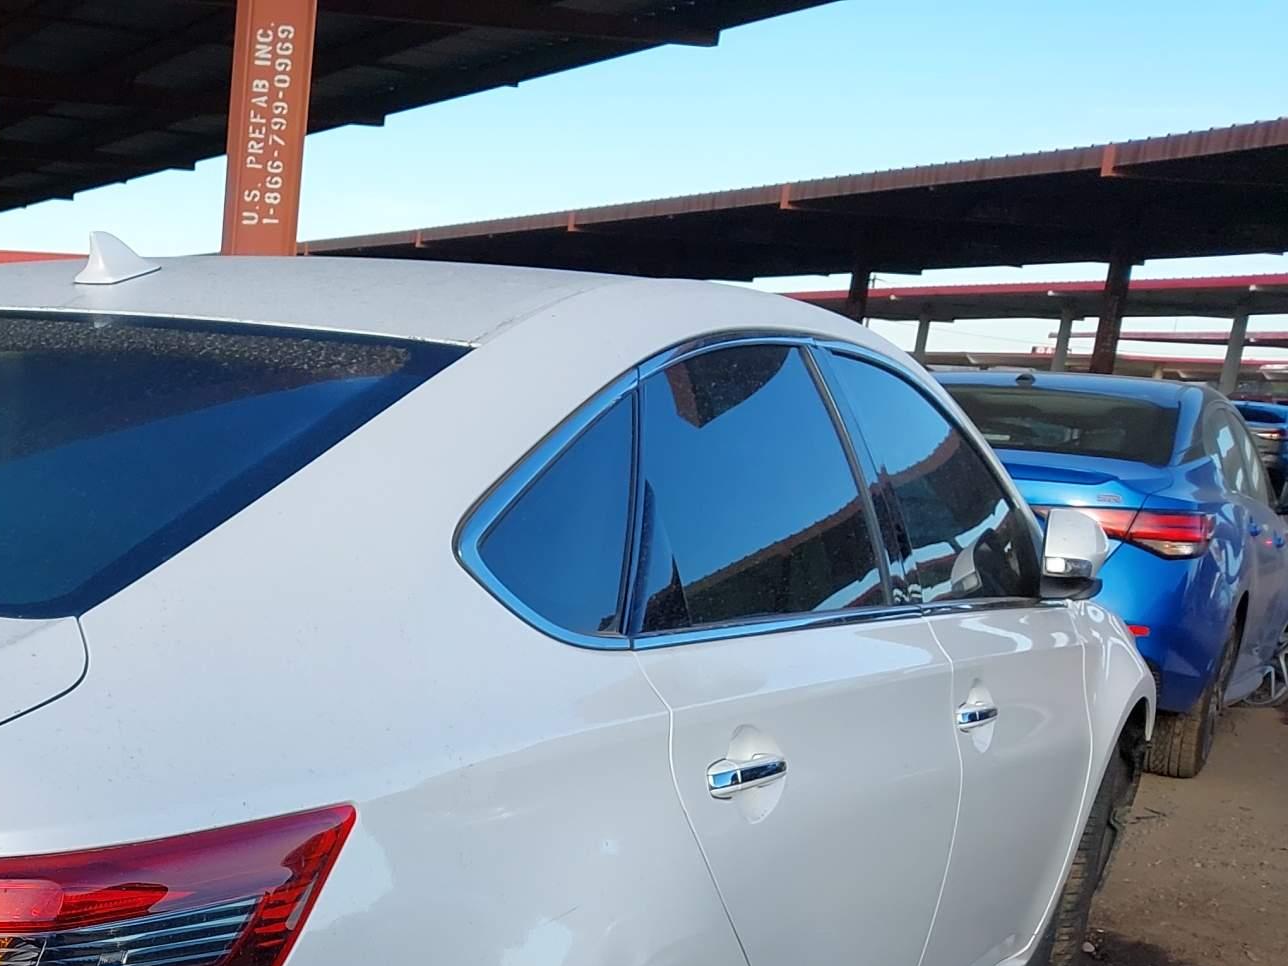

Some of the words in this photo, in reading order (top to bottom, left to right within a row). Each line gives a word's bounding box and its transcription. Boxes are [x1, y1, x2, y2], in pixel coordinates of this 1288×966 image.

[254, 22, 275, 66] INC.
[246, 79, 269, 169] PREFAB
[262, 24, 295, 225] 1-866-799-0969
[242, 183, 262, 225] U.S.
